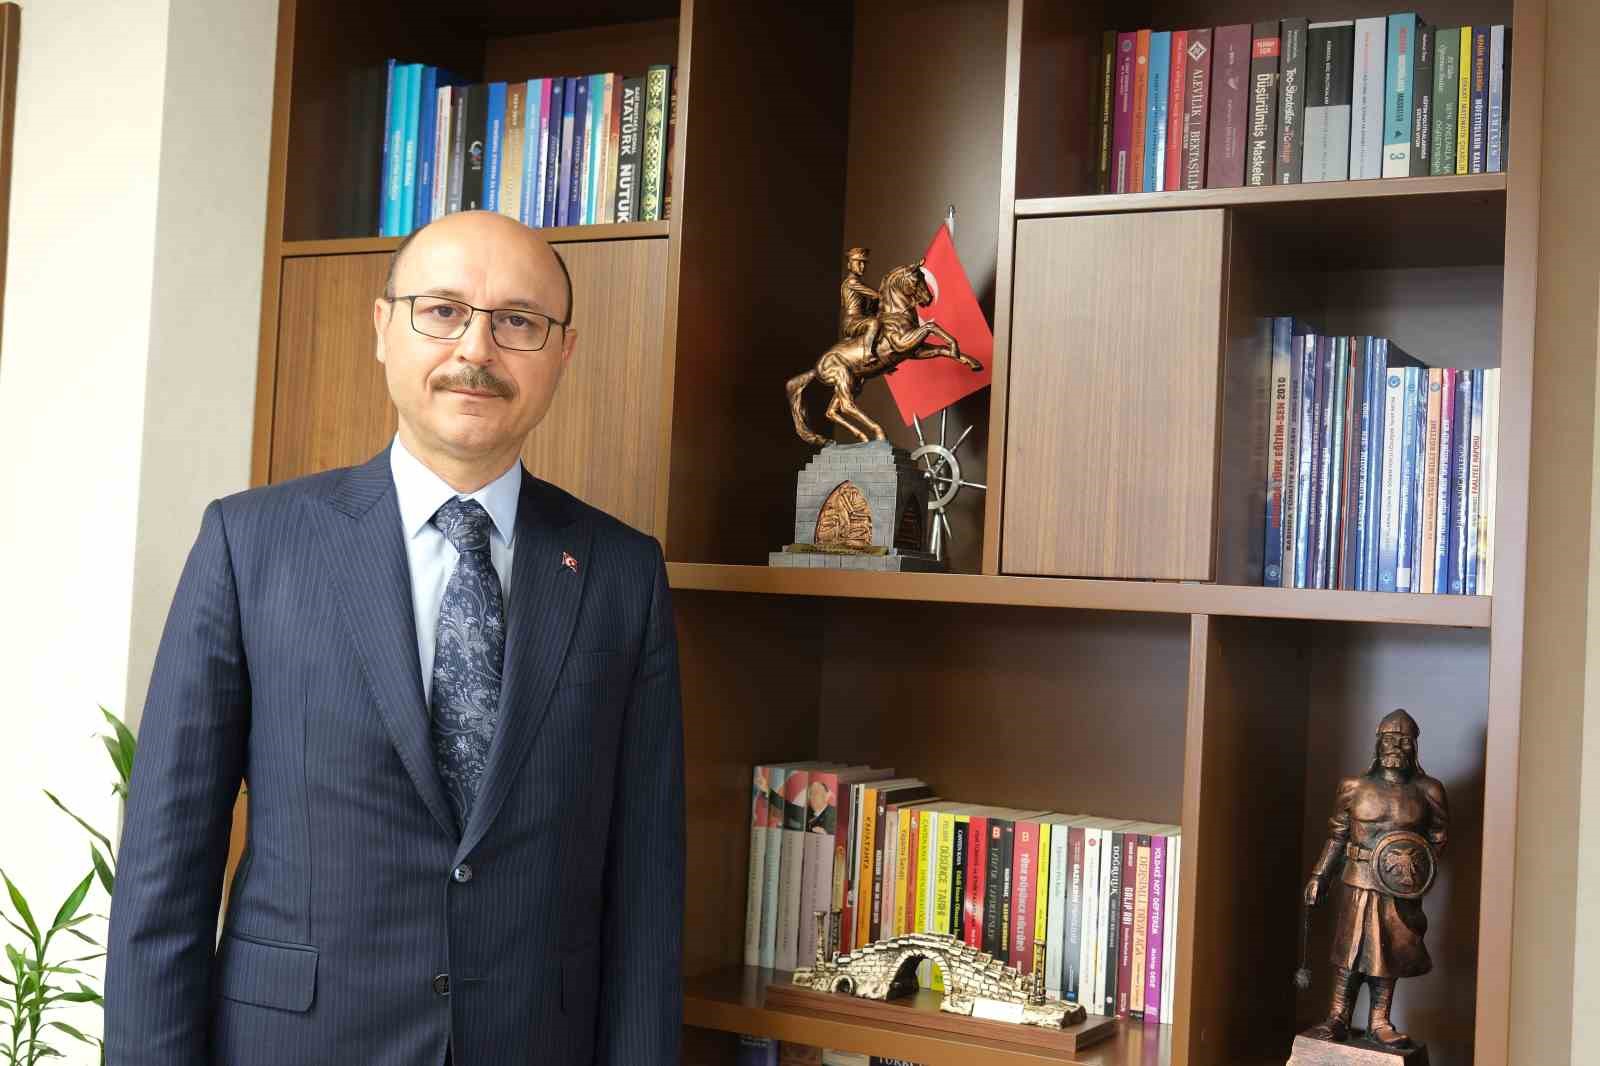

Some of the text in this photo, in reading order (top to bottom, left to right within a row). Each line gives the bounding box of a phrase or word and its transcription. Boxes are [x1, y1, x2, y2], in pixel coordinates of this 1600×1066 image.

[1190, 68, 1204, 118] ALEVİLİK
[1252, 73, 1272, 138] Düşürülmüş
[617, 88, 636, 224] ATATÜRK NUTUK
[1251, 140, 1267, 186] Maskeler
[1276, 376, 1287, 400] 2010
[1110, 845, 1120, 894] DOĞRULUK
